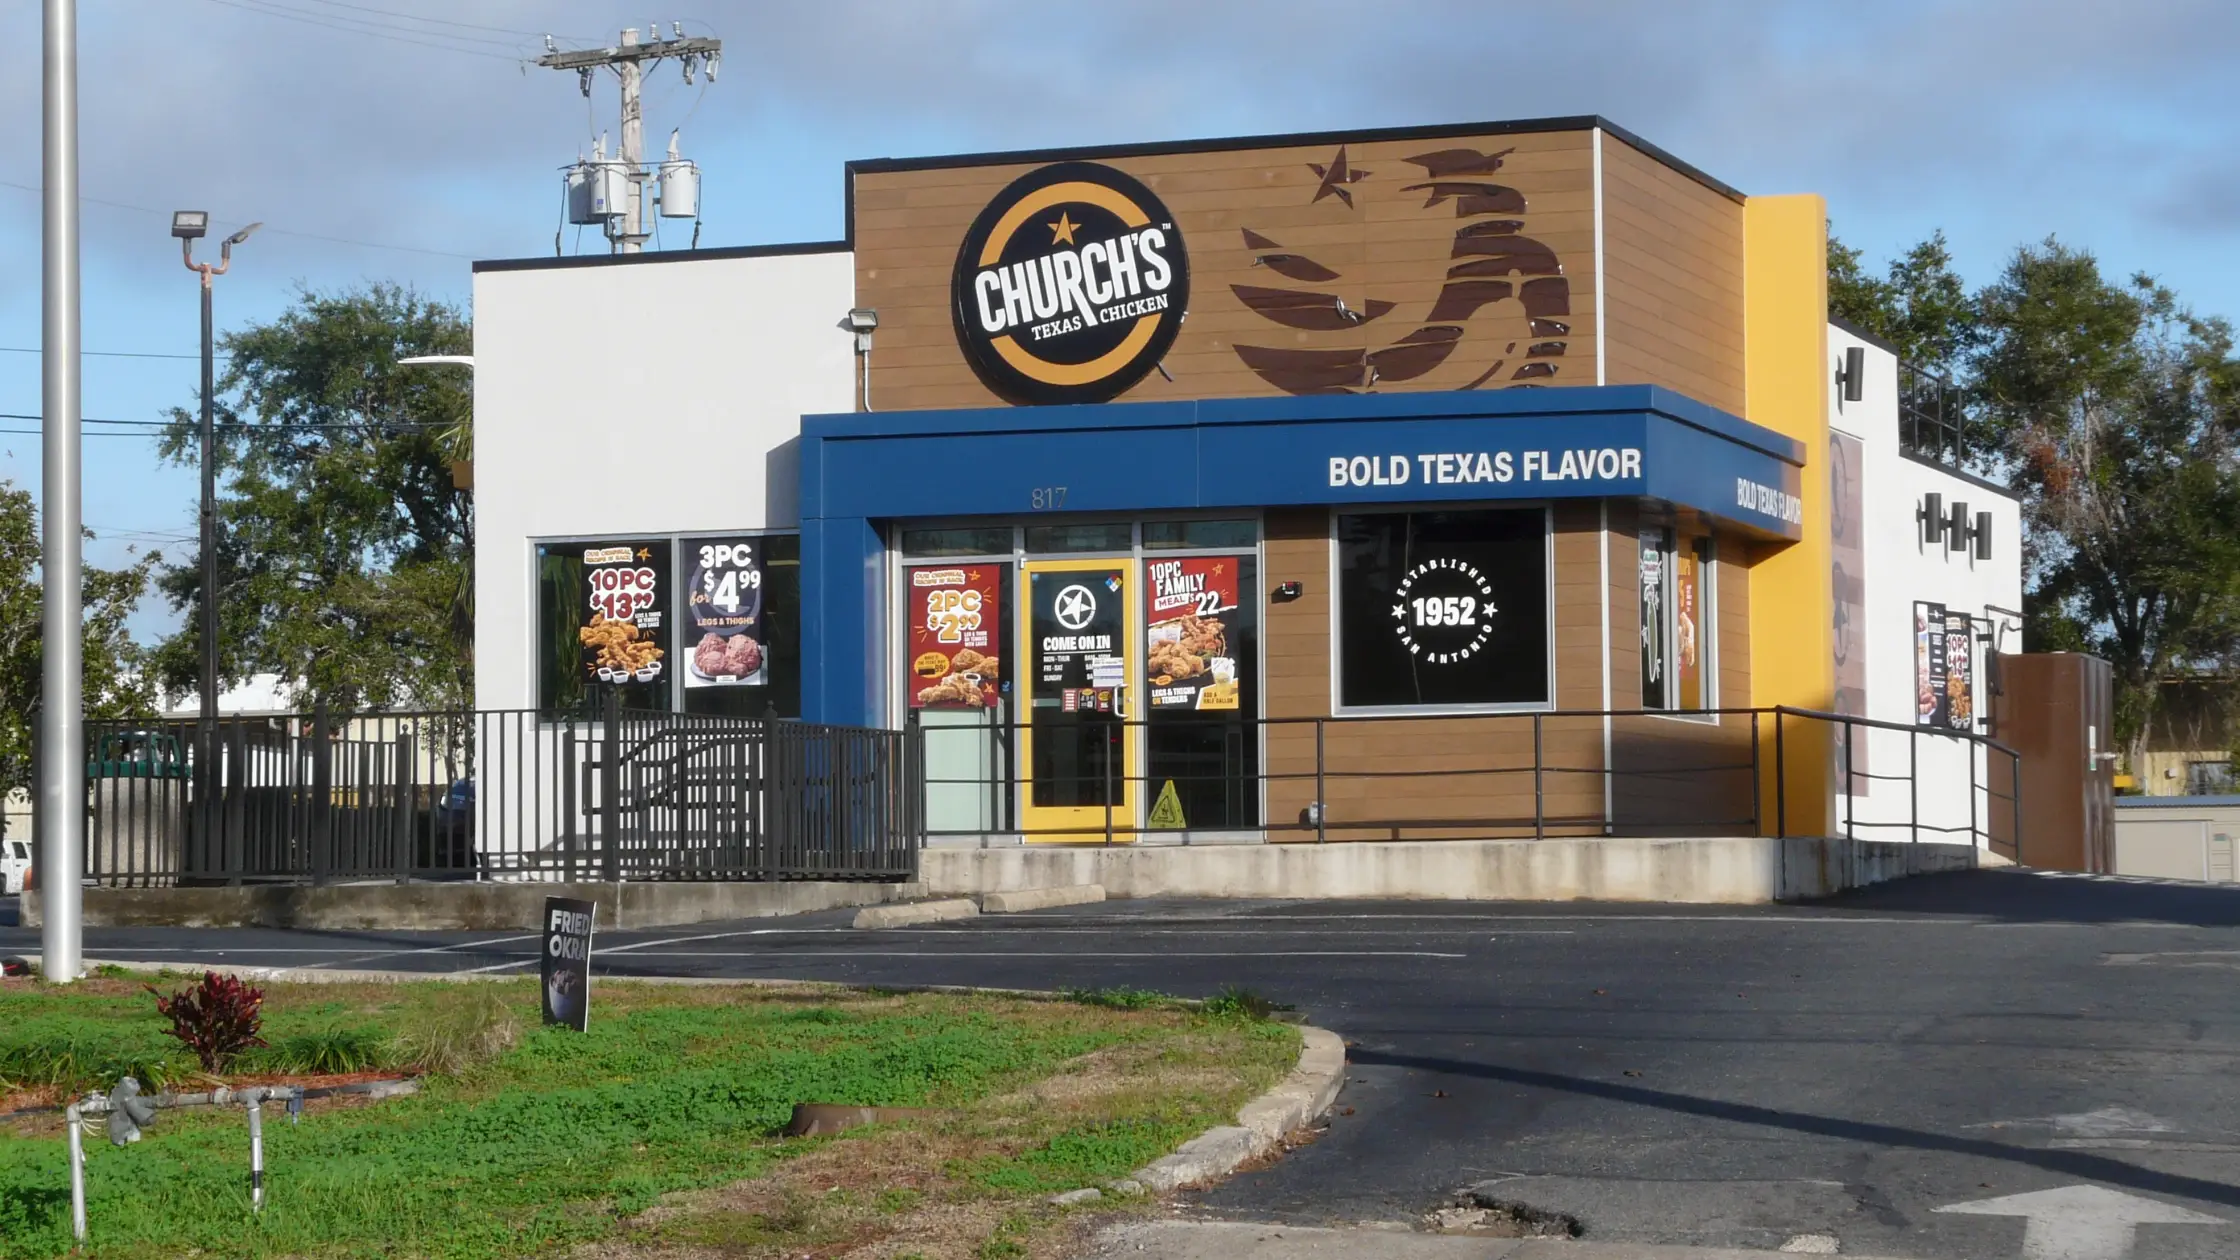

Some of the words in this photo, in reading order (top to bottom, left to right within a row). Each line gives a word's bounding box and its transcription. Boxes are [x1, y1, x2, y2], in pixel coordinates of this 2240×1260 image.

[975, 228, 1172, 332] CHURCH'S
[1031, 316, 1082, 340] TEXAS
[1100, 294, 1169, 324] CHICKEN
[1329, 456, 1410, 487] BOLD
[1418, 452, 1514, 484] TEXAS
[1523, 448, 1642, 482] FLAVOR
[1032, 486, 1067, 509] 817
[1737, 477, 1757, 510] BOLD
[1757, 484, 1778, 518] TEXAS
[1778, 491, 1801, 524] FLAVOR
[700, 544, 752, 568] 3PC
[591, 569, 653, 591] 10PC
[1149, 561, 1182, 581] 10PC
[1396, 558, 1492, 597] ESTABLISHED
[1156, 573, 1205, 597] FAMILY
[689, 590, 711, 606] for
[930, 591, 979, 612] 2PC
[1158, 596, 1185, 608] MEAL
[697, 618, 717, 627] LEGS
[726, 616, 755, 626] THIGHS
[1412, 596, 1476, 626] 1952
[1043, 636, 1077, 651] COME
[1078, 635, 1095, 650] ON
[1096, 635, 1111, 649] IN
[1396, 625, 1420, 654] SAN
[1427, 624, 1493, 664] ANTONIO
[550, 909, 591, 937] FRIED
[549, 934, 587, 961] OKRA
